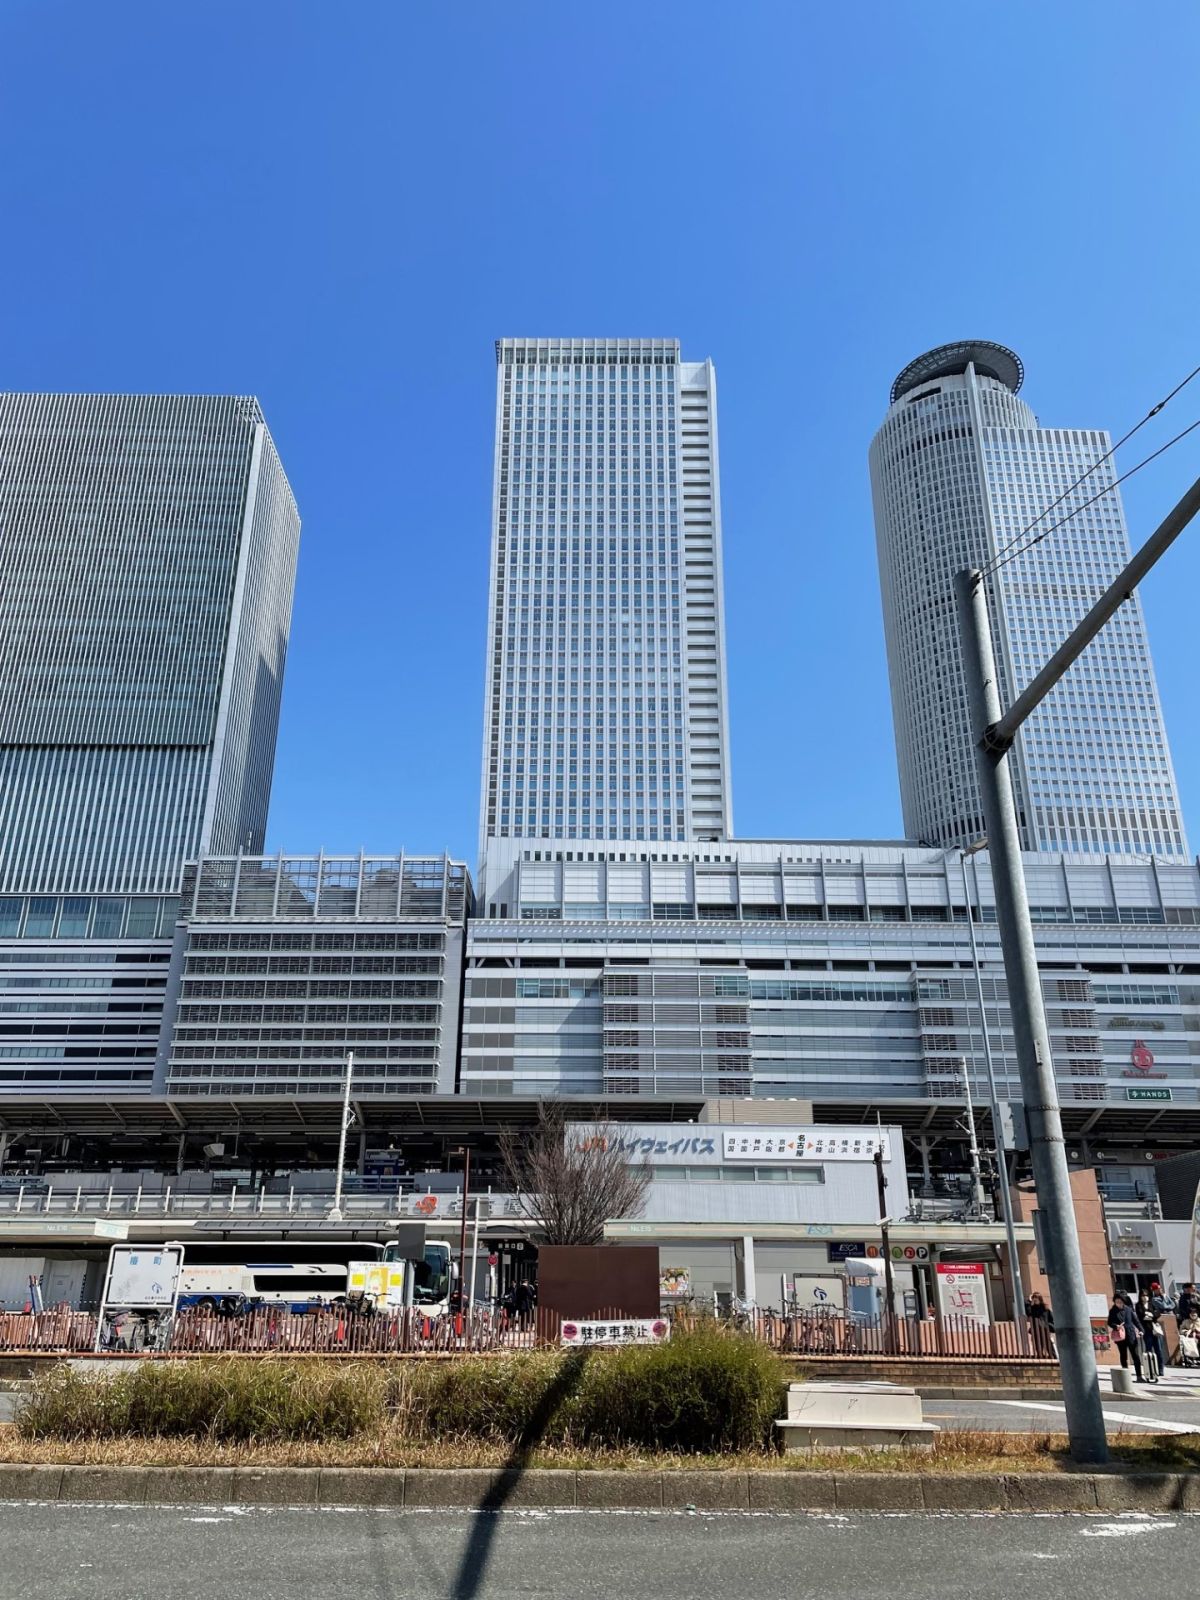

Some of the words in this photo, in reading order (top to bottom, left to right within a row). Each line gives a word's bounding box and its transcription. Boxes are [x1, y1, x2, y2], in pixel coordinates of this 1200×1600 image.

[581, 1325, 648, 1340] 駐停車禁止
